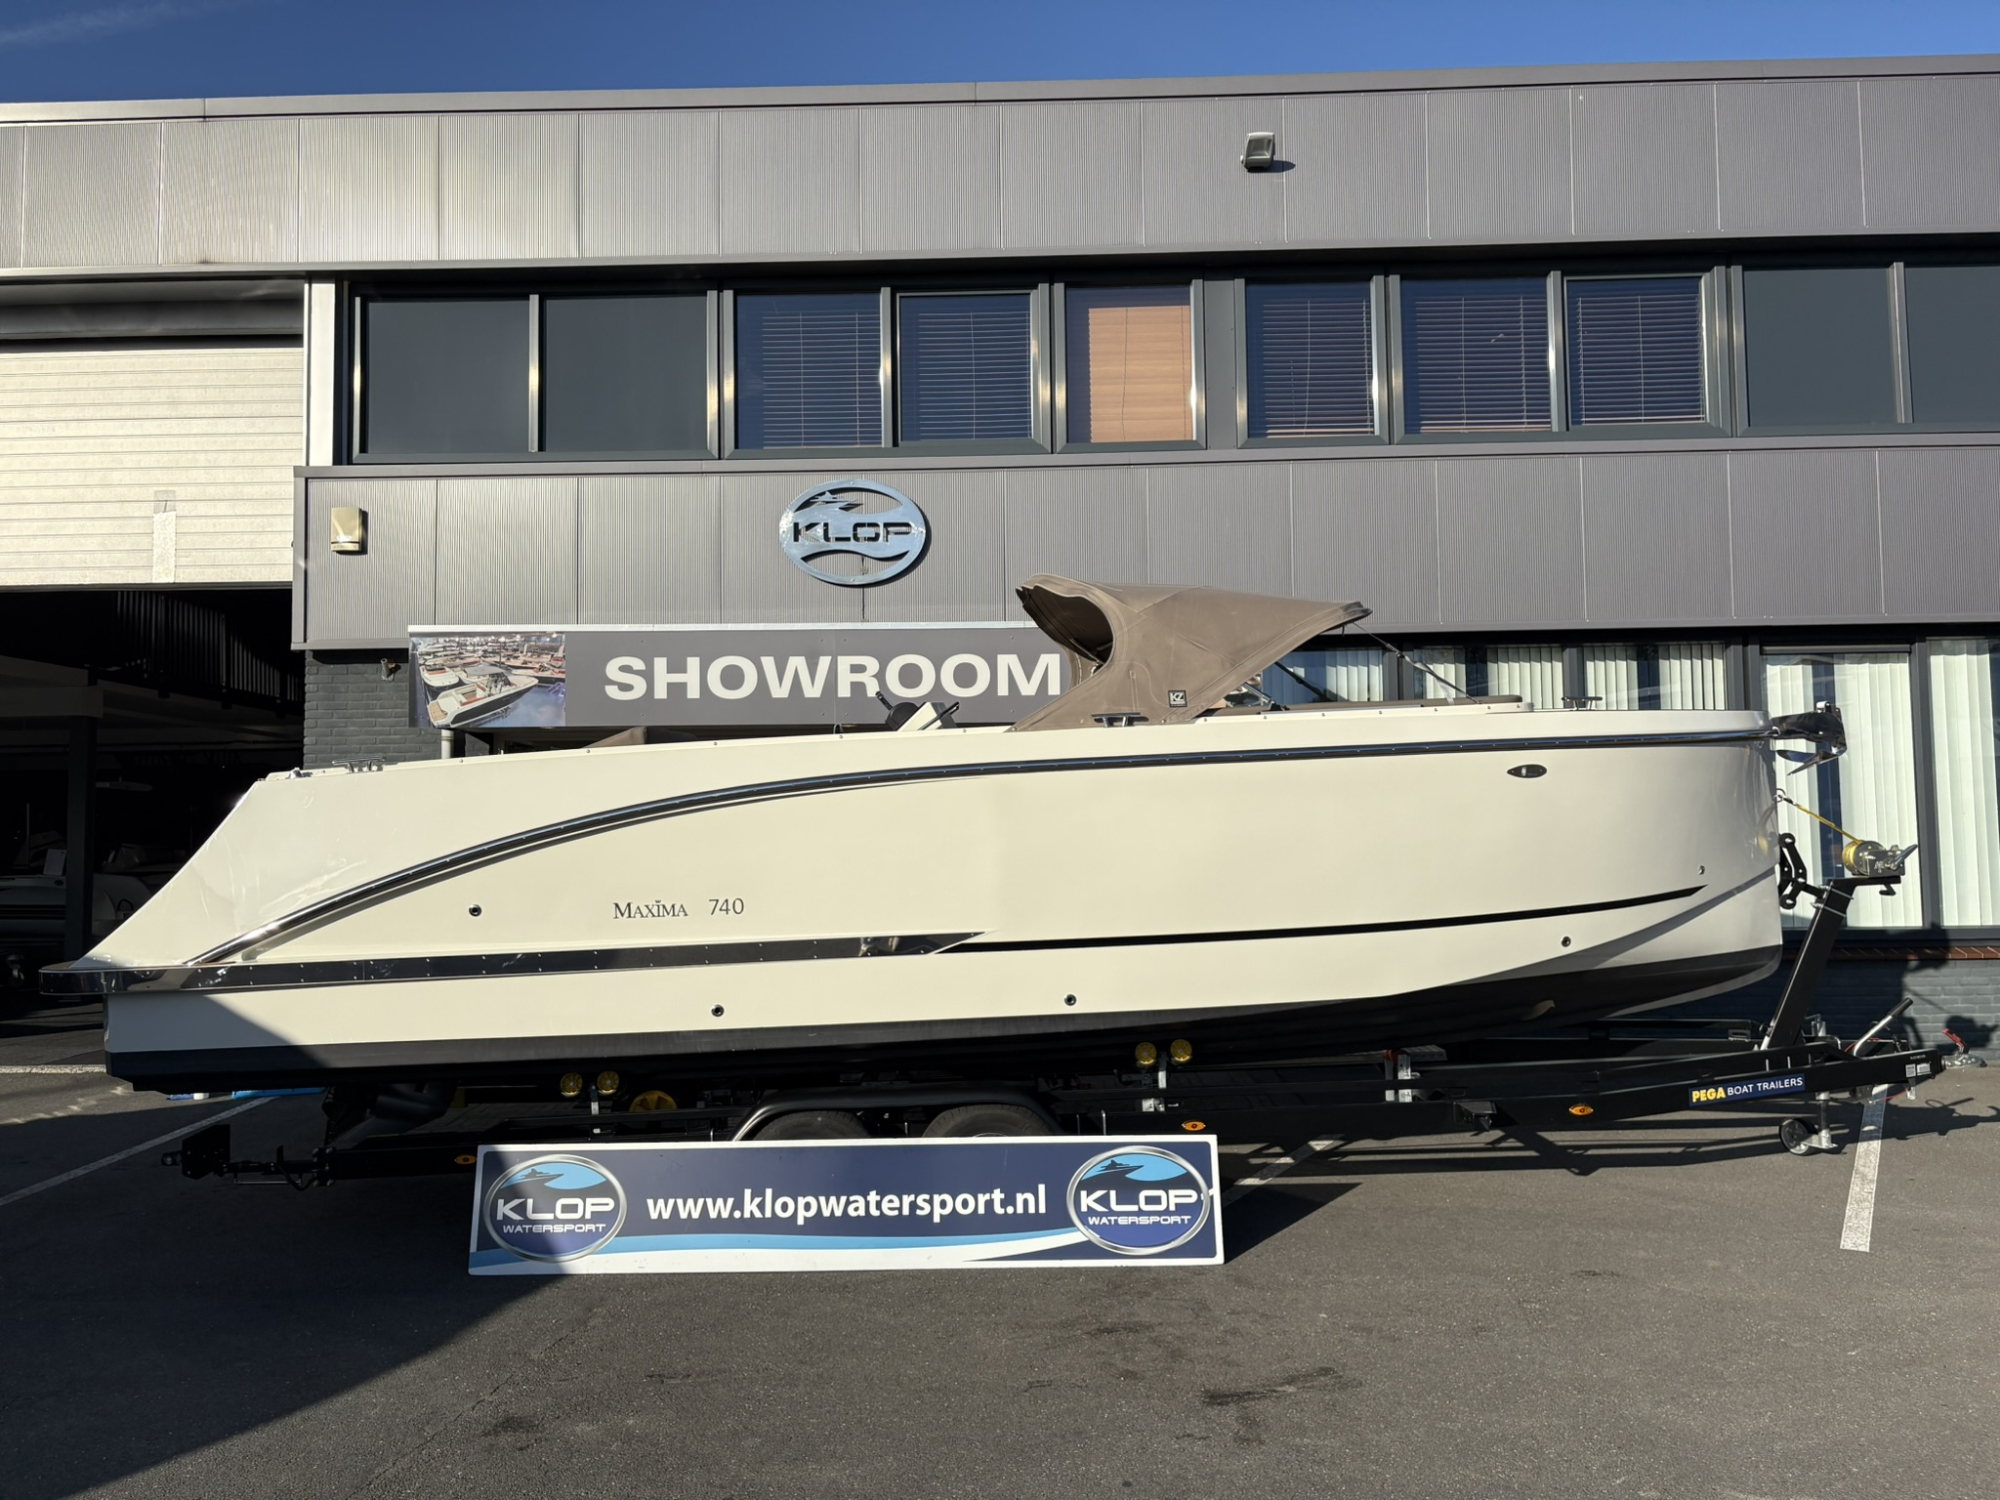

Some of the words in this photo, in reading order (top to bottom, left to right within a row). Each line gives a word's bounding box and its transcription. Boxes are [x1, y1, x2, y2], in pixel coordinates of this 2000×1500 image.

[793, 522, 913, 542] KLOP
[604, 653, 1061, 699] SHOWROOM
[708, 897, 745, 916] 740
[1692, 1086, 1726, 1103] PEGA
[1727, 1083, 1754, 1096] BOAT
[1756, 1076, 1803, 1092] TRAILERS
[496, 1197, 615, 1221] KLOP
[646, 1184, 1046, 1225] www.klopwatersport.nl
[1080, 1189, 1198, 1212] KLOP
[502, 1223, 606, 1234] WATERSPORT
[1088, 1215, 1192, 1226] WATERSPORT
